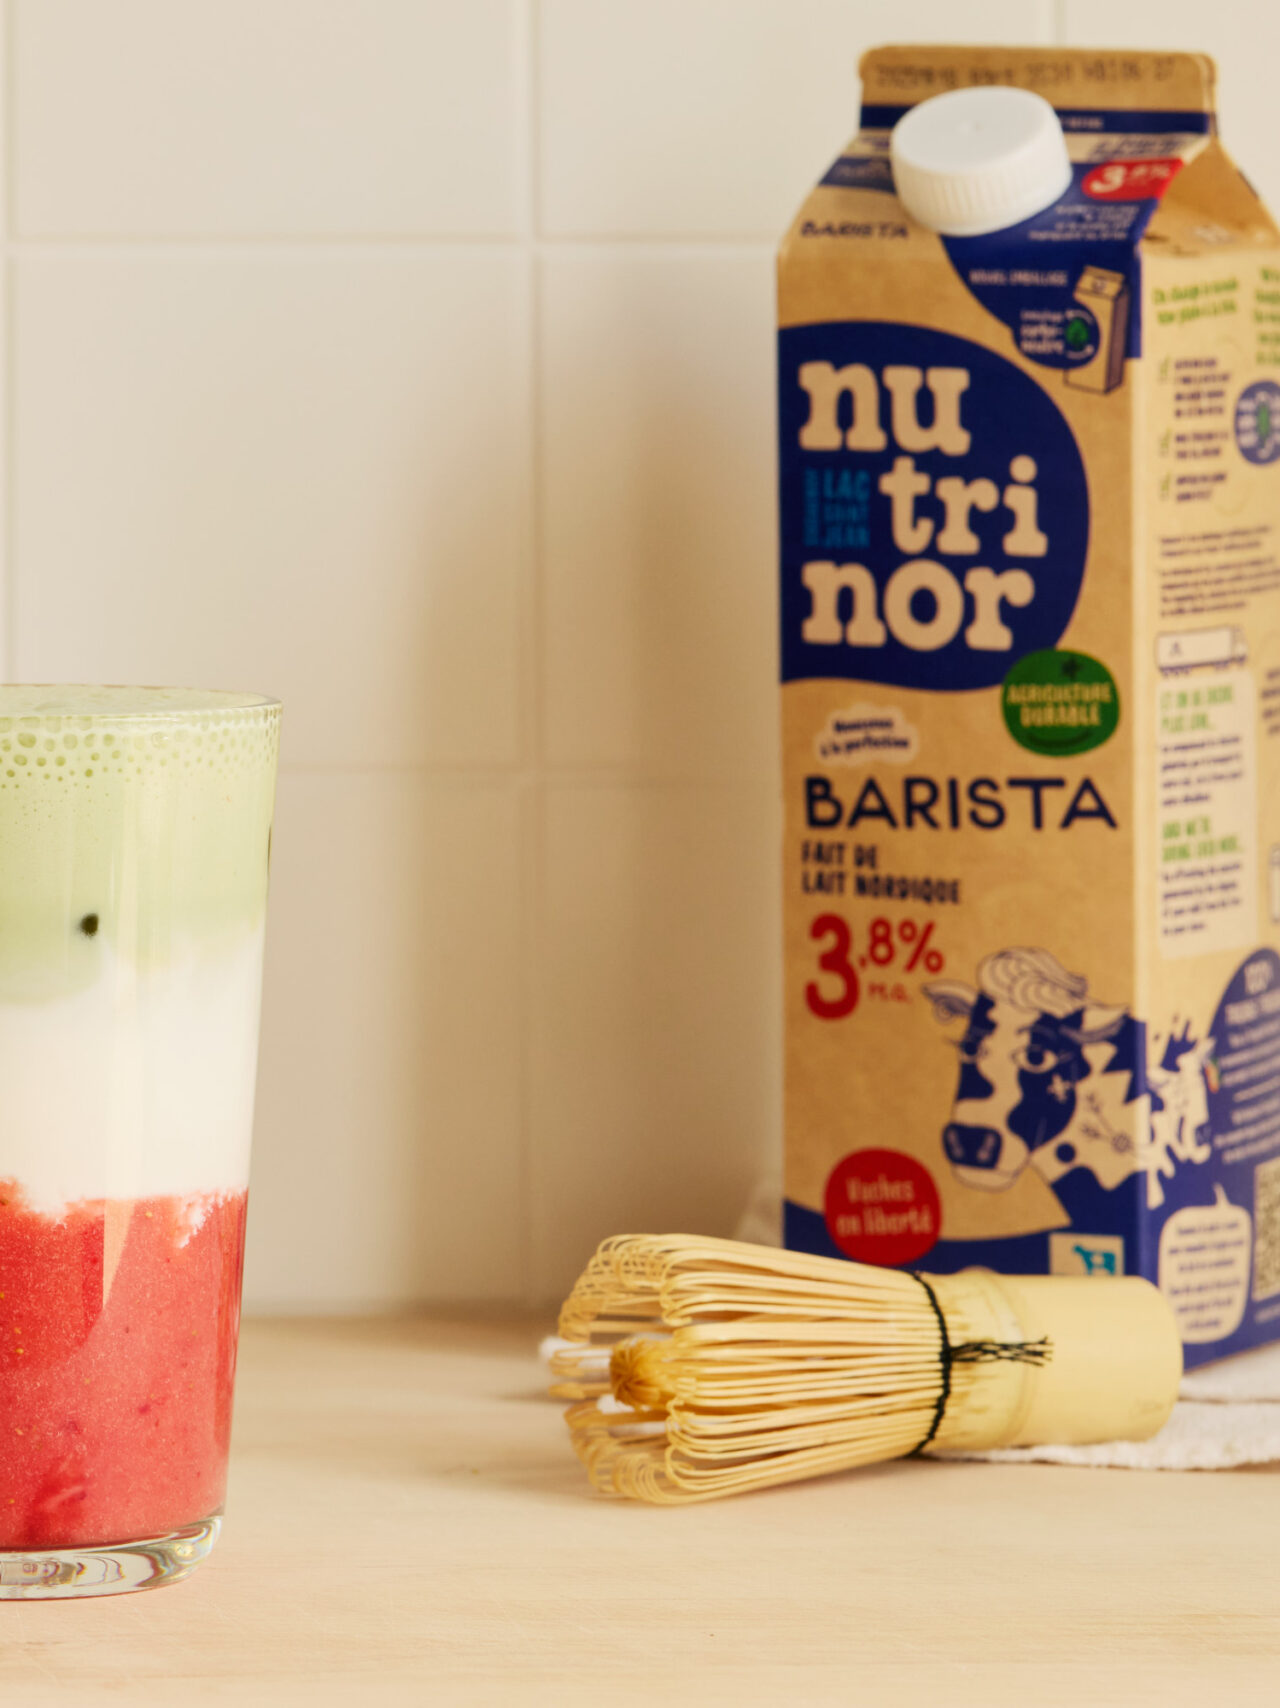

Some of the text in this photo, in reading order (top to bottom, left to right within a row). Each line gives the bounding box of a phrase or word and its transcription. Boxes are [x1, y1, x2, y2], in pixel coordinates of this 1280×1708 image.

[802, 220, 908, 238] BARISTA
[799, 361, 970, 456] nu
[879, 455, 1048, 557] tri
[801, 559, 1035, 651] nor
[1007, 682, 1112, 704] AGRICULTURE
[1021, 703, 1101, 727] DURABLE
[804, 775, 1118, 831] BARISTA
[801, 840, 878, 869] FAIT DE
[801, 870, 961, 905] LAIT NORDIQUE
[837, 1205, 933, 1236] en liberté
